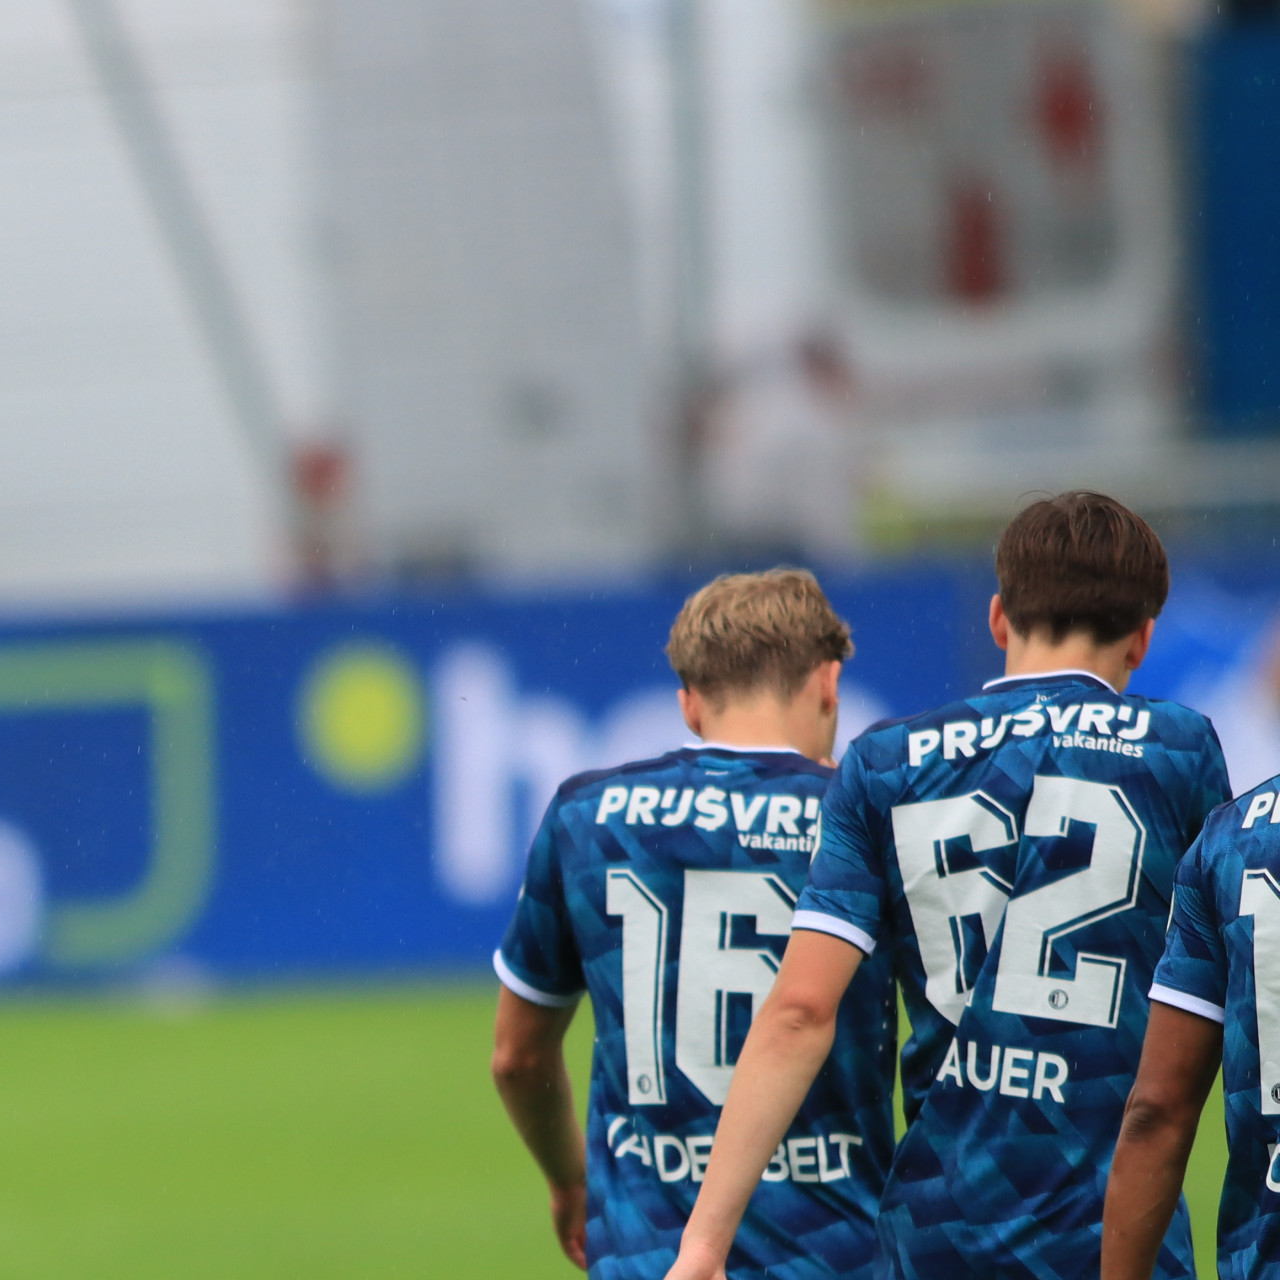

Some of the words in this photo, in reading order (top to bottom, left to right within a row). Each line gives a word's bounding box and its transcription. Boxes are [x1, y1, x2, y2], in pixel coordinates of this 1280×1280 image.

[1053, 732, 1144, 758] vakanties
[606, 868, 798, 1106] 16
[891, 774, 1147, 1029] 62
